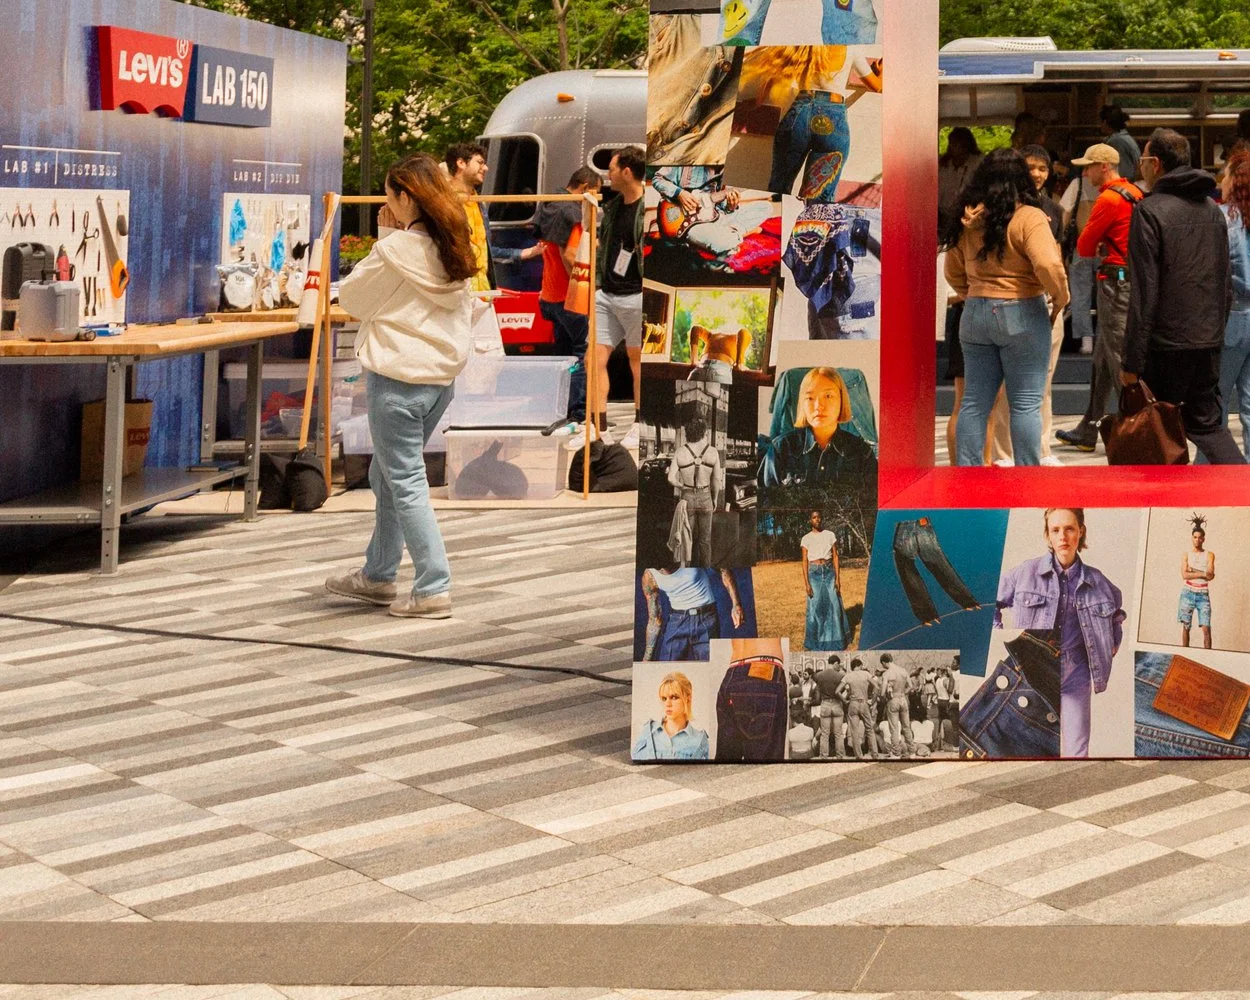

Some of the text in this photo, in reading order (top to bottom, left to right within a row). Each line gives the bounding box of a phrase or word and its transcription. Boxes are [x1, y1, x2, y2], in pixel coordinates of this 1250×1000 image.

[201, 63, 268, 110] LAB 150
[4, 160, 117, 177] LAB #1 DISTRESS
[233, 171, 249, 182] LAB
